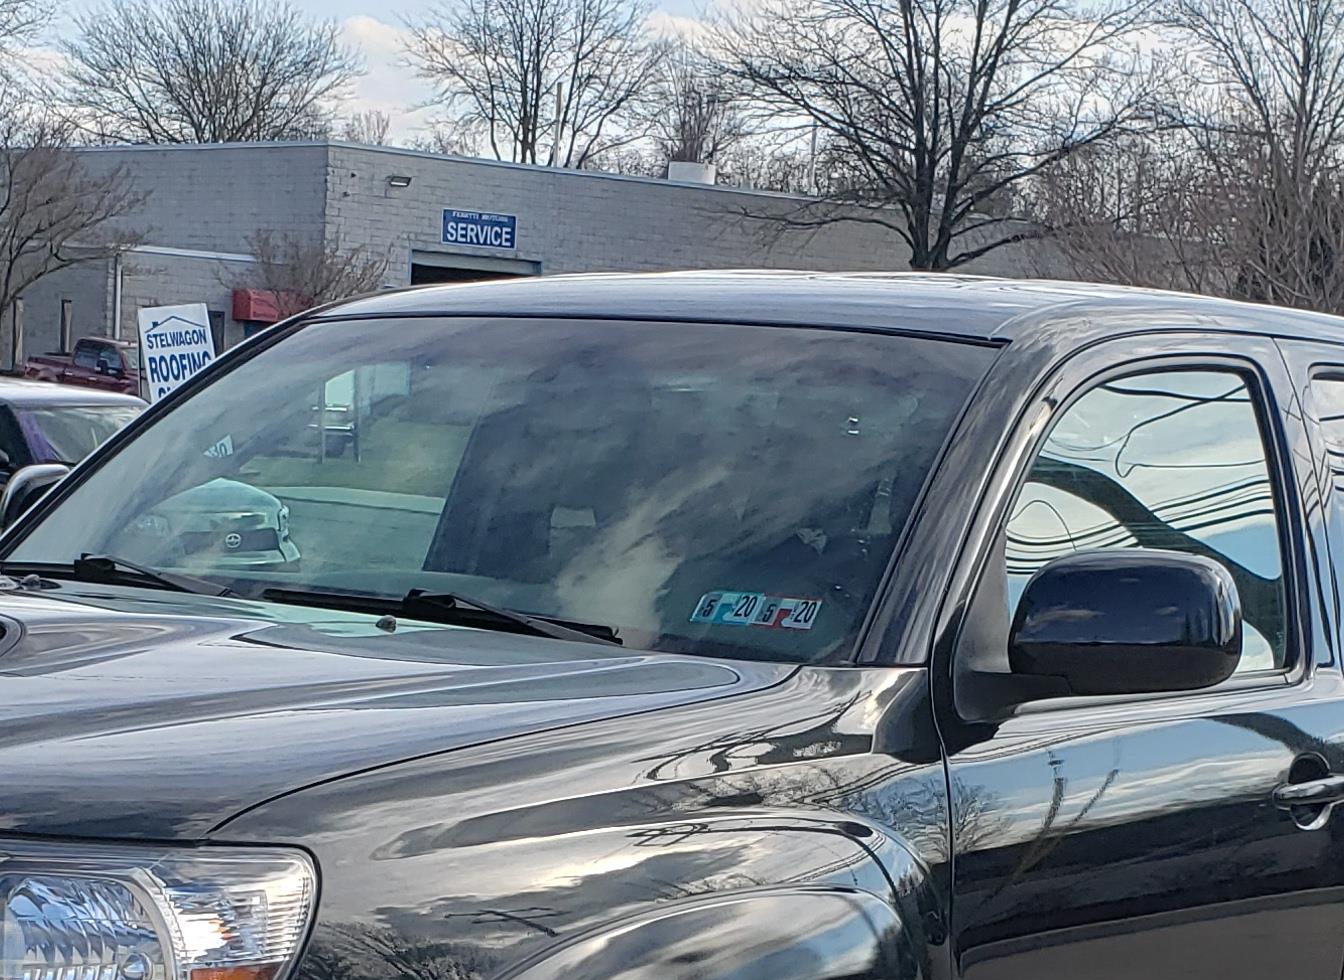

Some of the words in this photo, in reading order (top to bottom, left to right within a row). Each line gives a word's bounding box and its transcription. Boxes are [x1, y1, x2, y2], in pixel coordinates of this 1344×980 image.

[446, 221, 512, 247] SERVICE
[146, 328, 208, 349] STELWAGON
[702, 599, 717, 618] 5
[733, 595, 759, 618] 20
[762, 604, 776, 623] 5
[792, 601, 817, 623] 20
